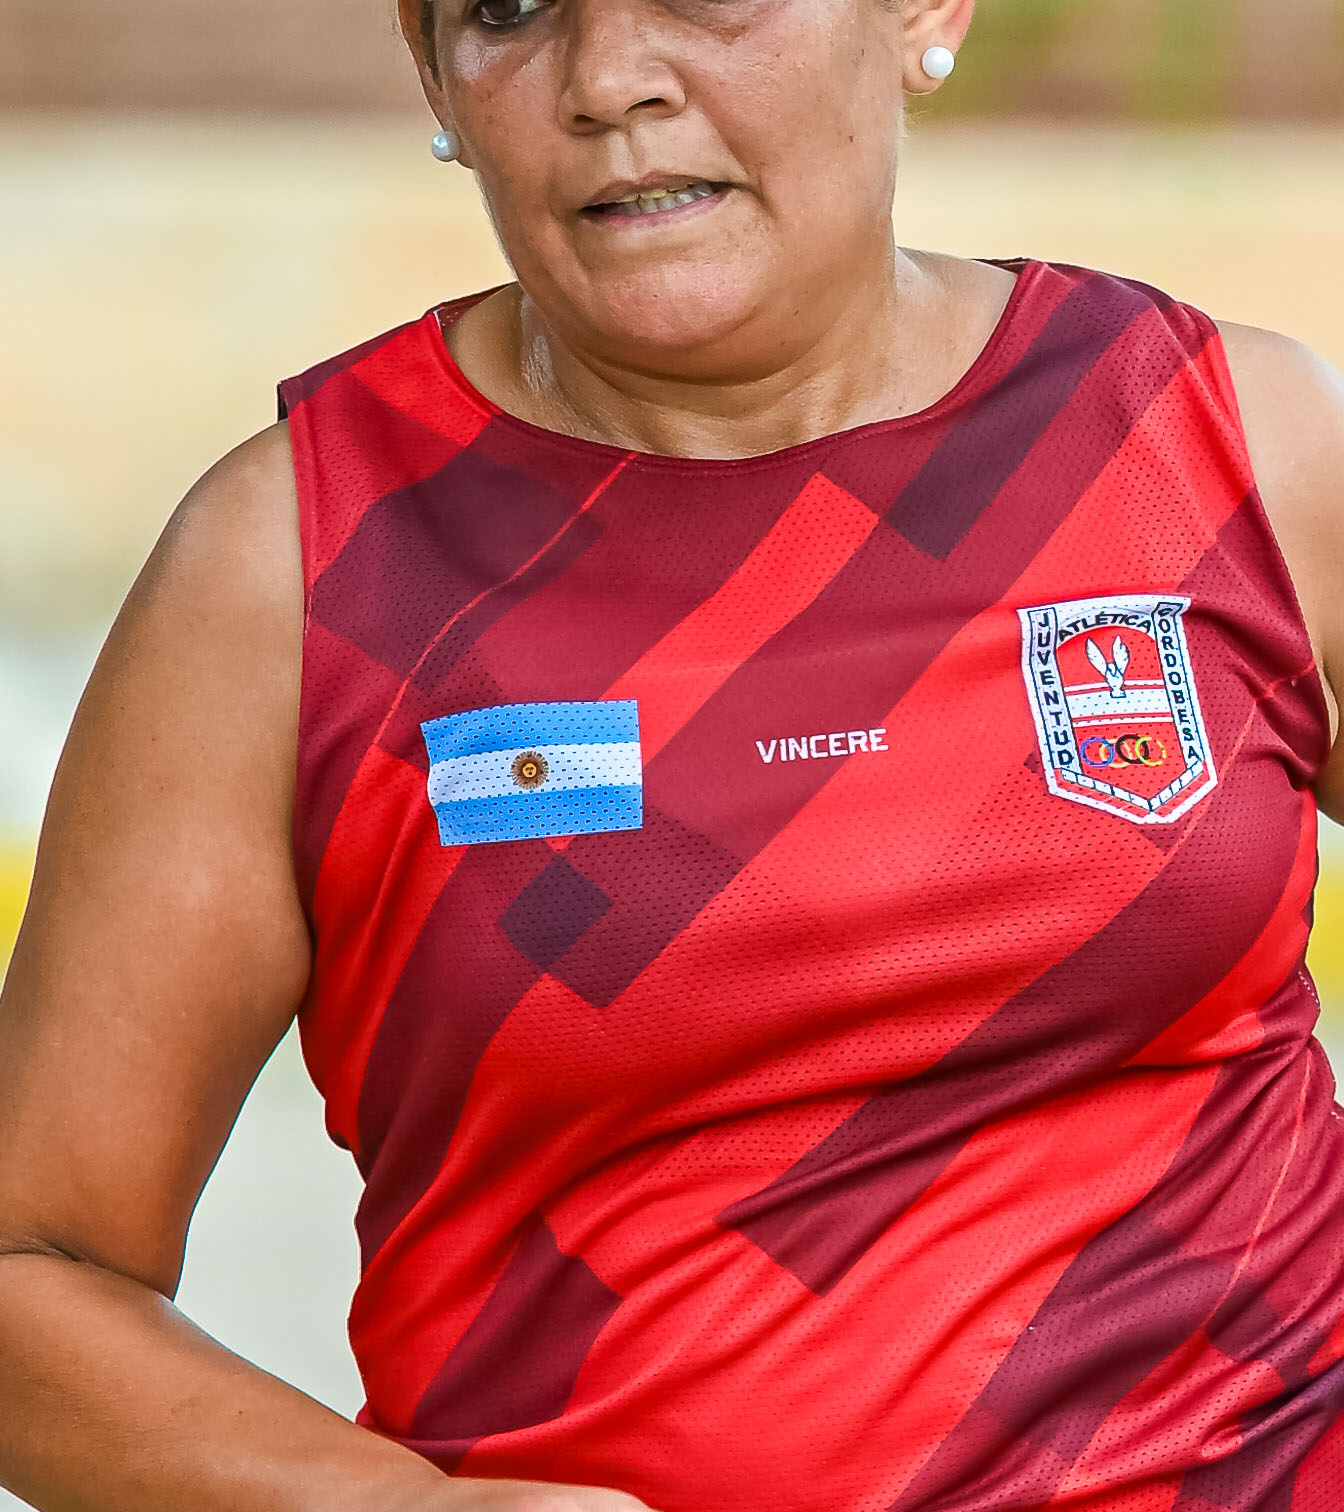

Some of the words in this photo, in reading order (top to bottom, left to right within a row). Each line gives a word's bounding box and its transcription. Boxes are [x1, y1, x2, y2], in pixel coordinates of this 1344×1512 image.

[1058, 611, 1152, 642] ATLÉTICA
[1036, 611, 1074, 766] JUVENTUD
[1157, 607, 1200, 762] CORDOBESA
[755, 728, 889, 764] VINCERE
